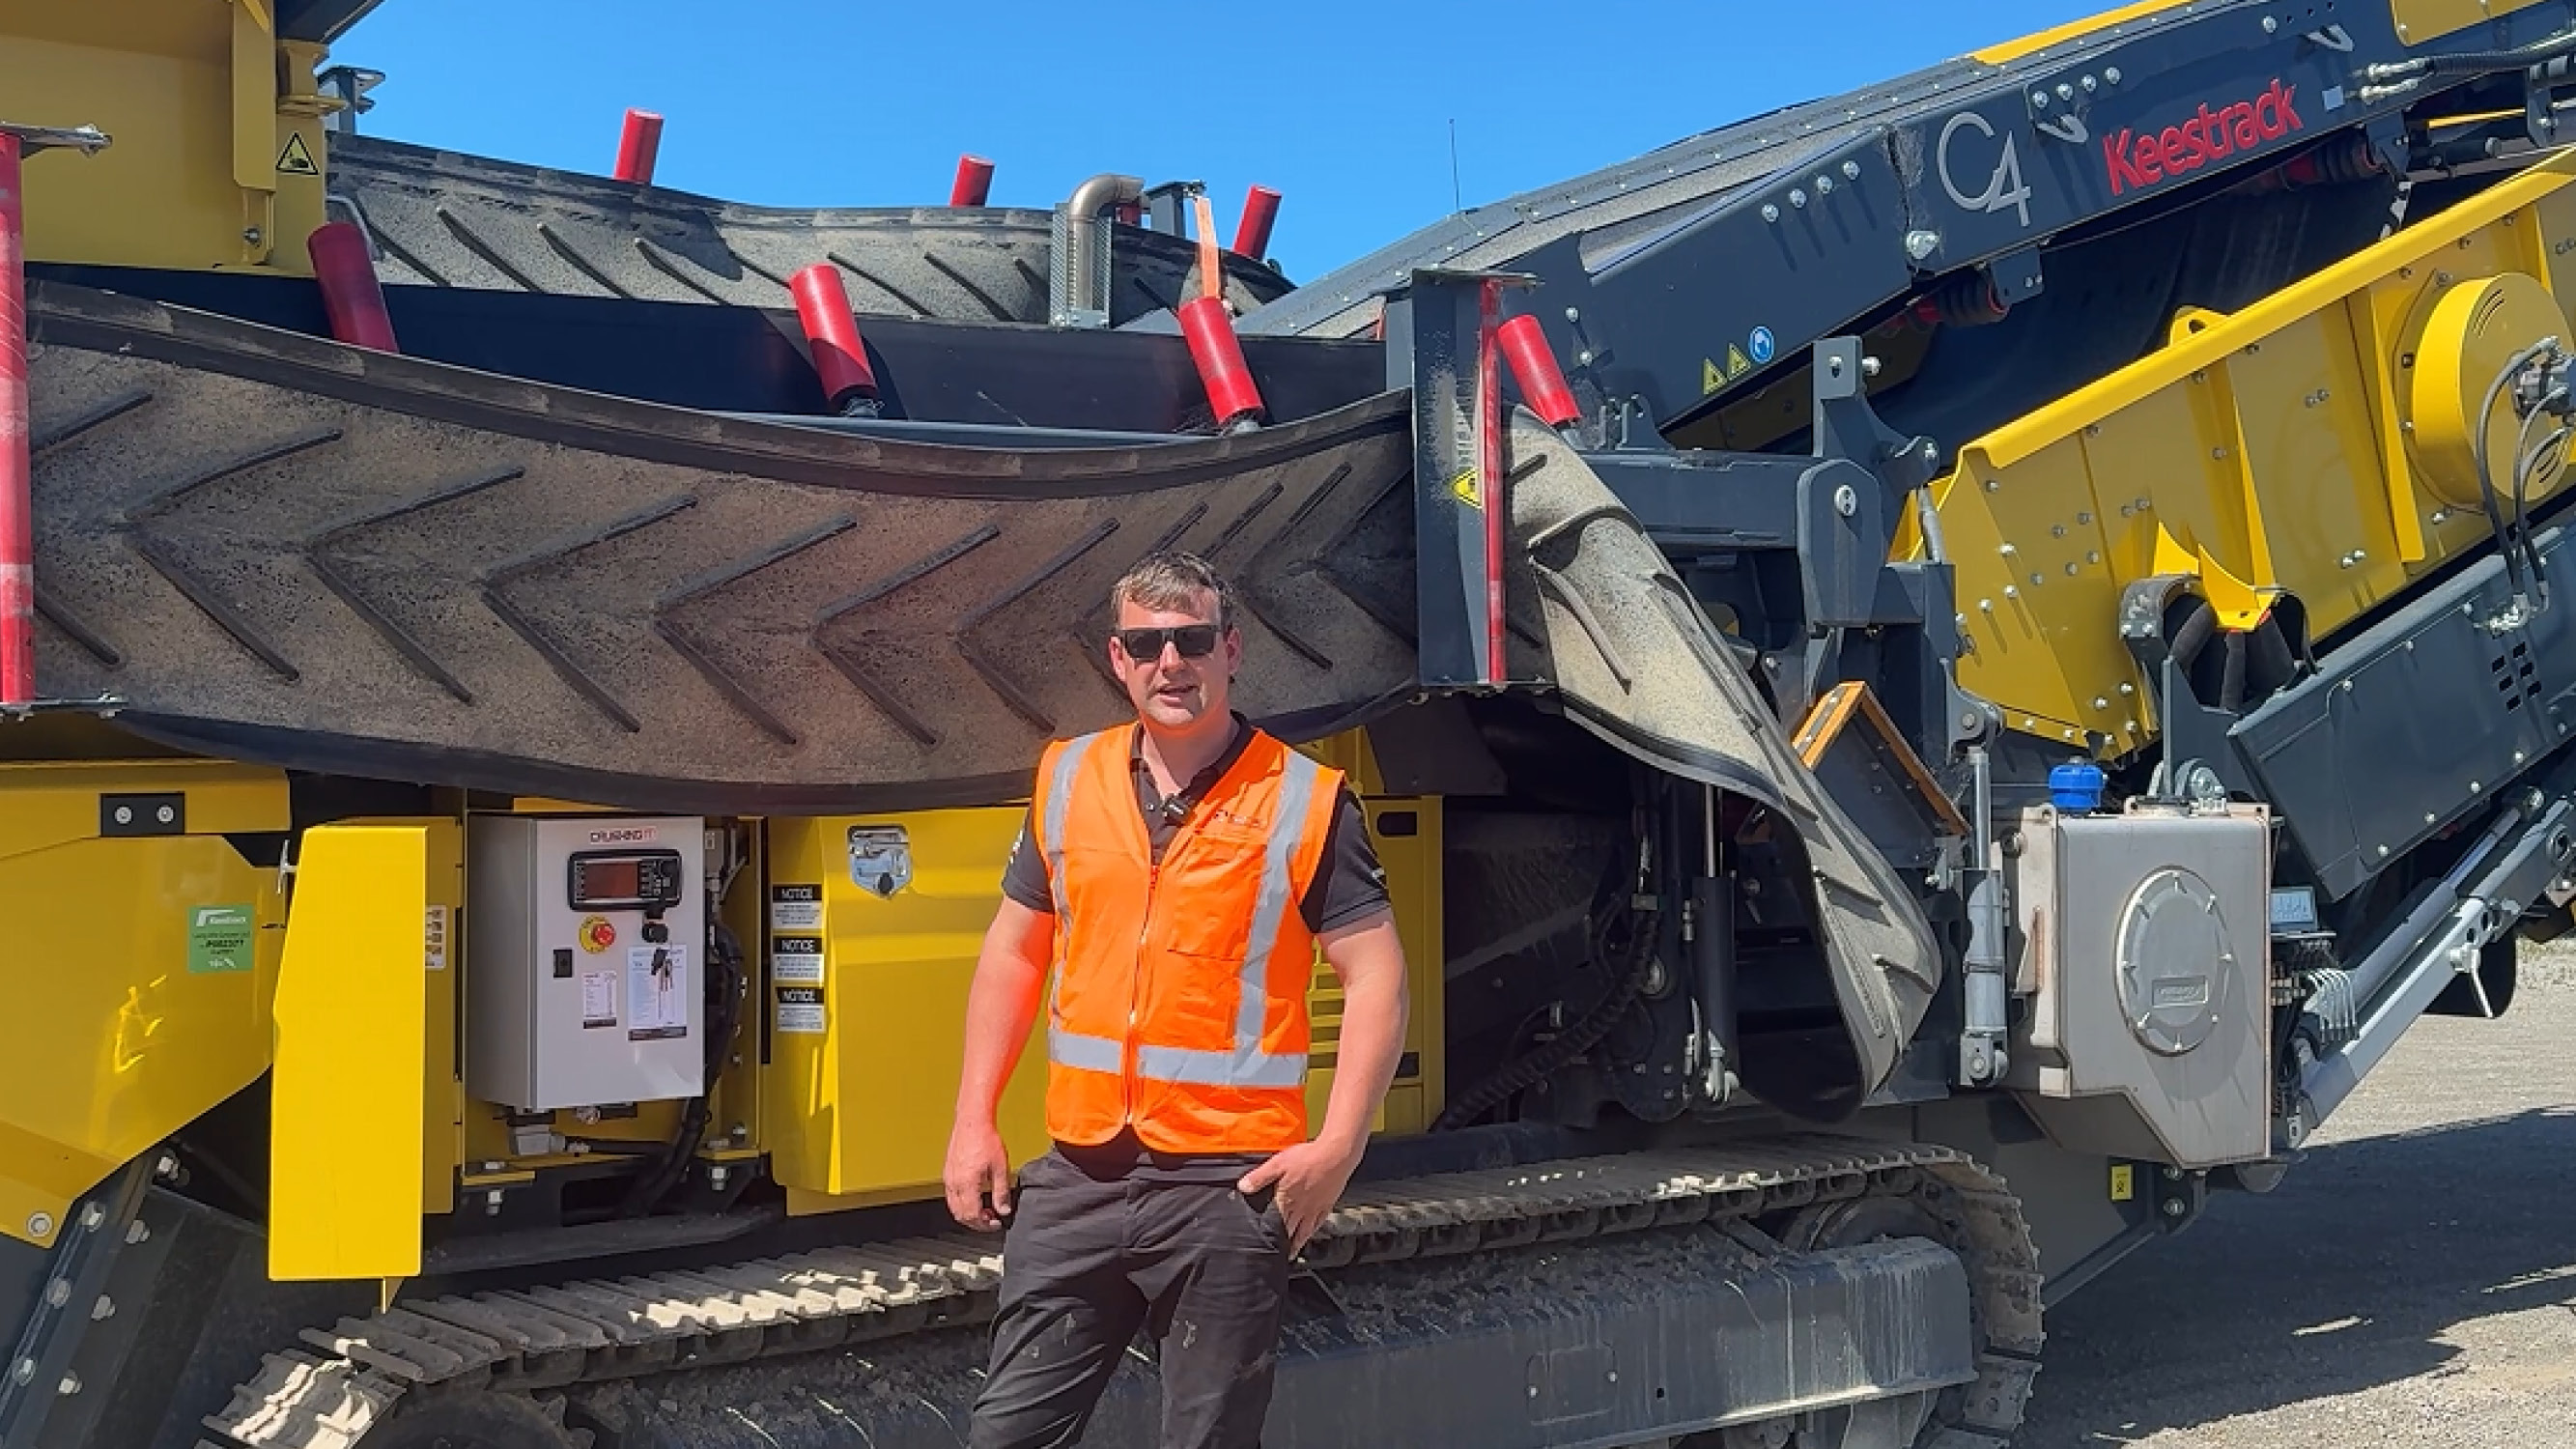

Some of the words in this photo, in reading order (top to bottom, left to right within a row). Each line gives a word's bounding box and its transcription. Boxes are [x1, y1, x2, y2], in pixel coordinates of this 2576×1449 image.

[2103, 76, 2304, 196] Keestrack
[1937, 111, 2031, 227] C4
[781, 887, 813, 899] NOTICE
[781, 939, 815, 952] NOTICE
[782, 989, 815, 1002] NOTICE
